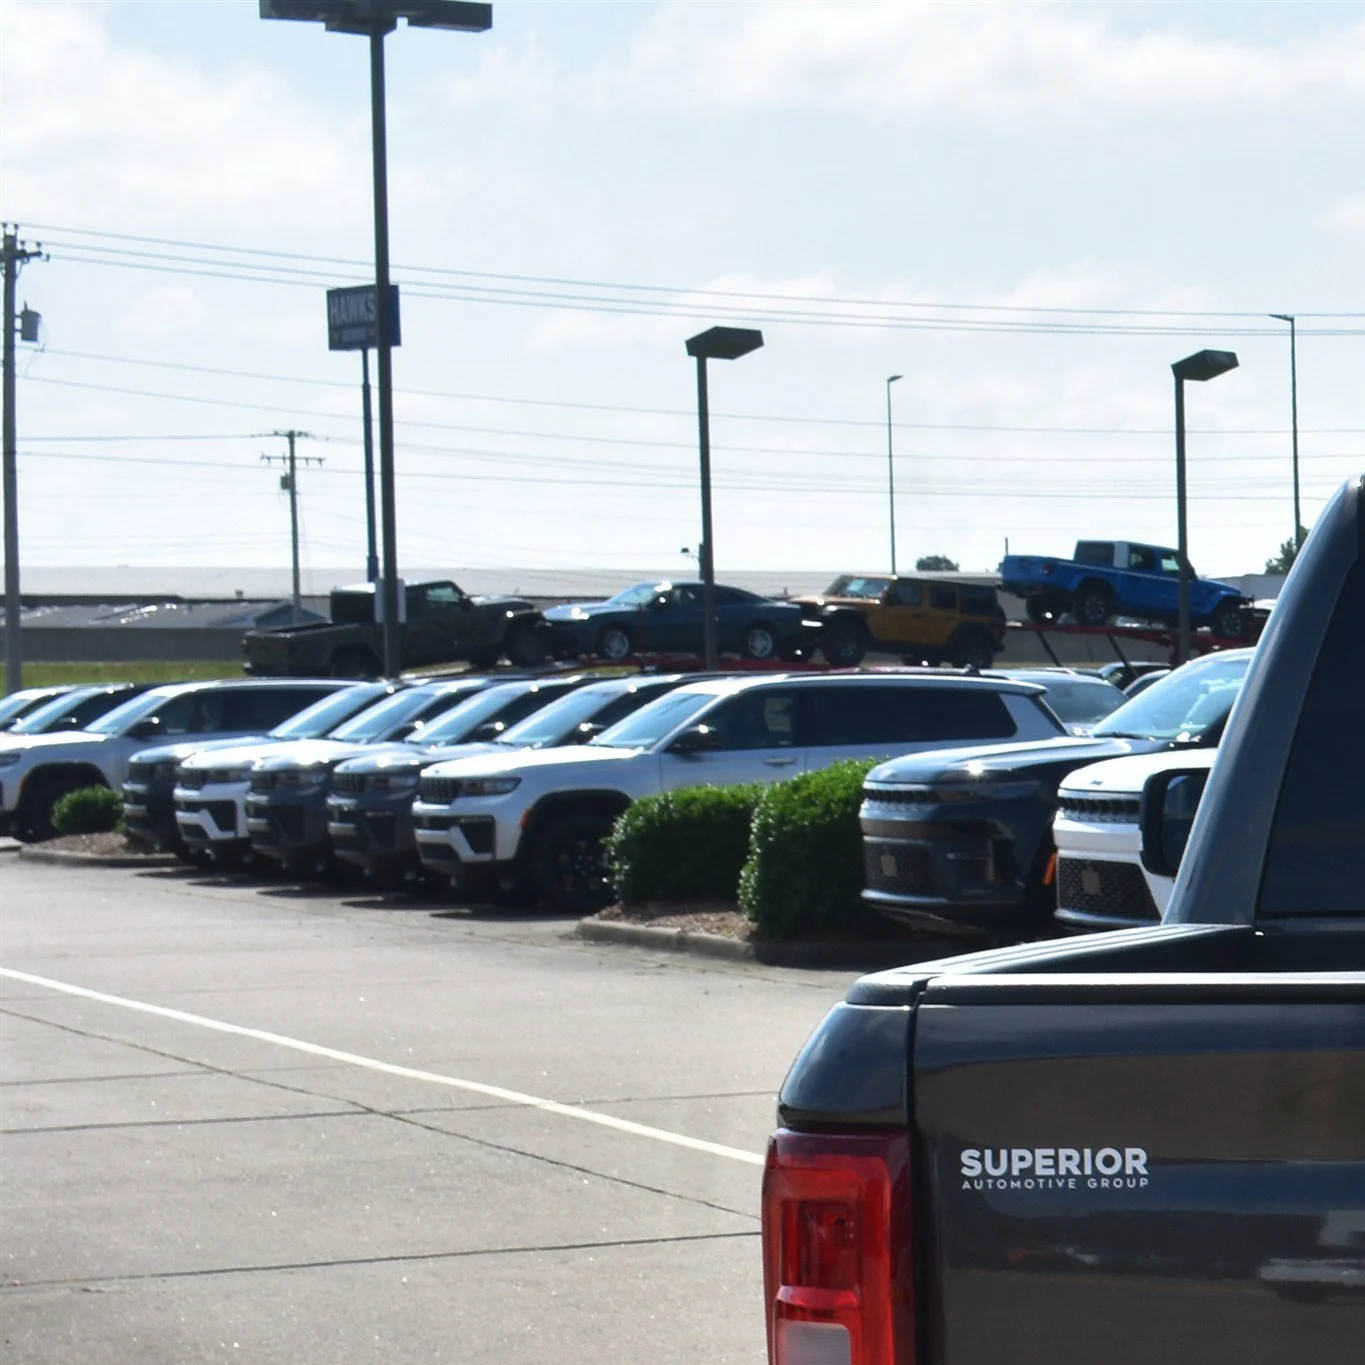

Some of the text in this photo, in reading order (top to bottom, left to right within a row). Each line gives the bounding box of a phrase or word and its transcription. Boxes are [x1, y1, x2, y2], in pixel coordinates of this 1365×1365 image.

[960, 1148, 1148, 1176] SUPERIOR
[961, 1178, 1149, 1189] AUTOMOTIVE GROUP
